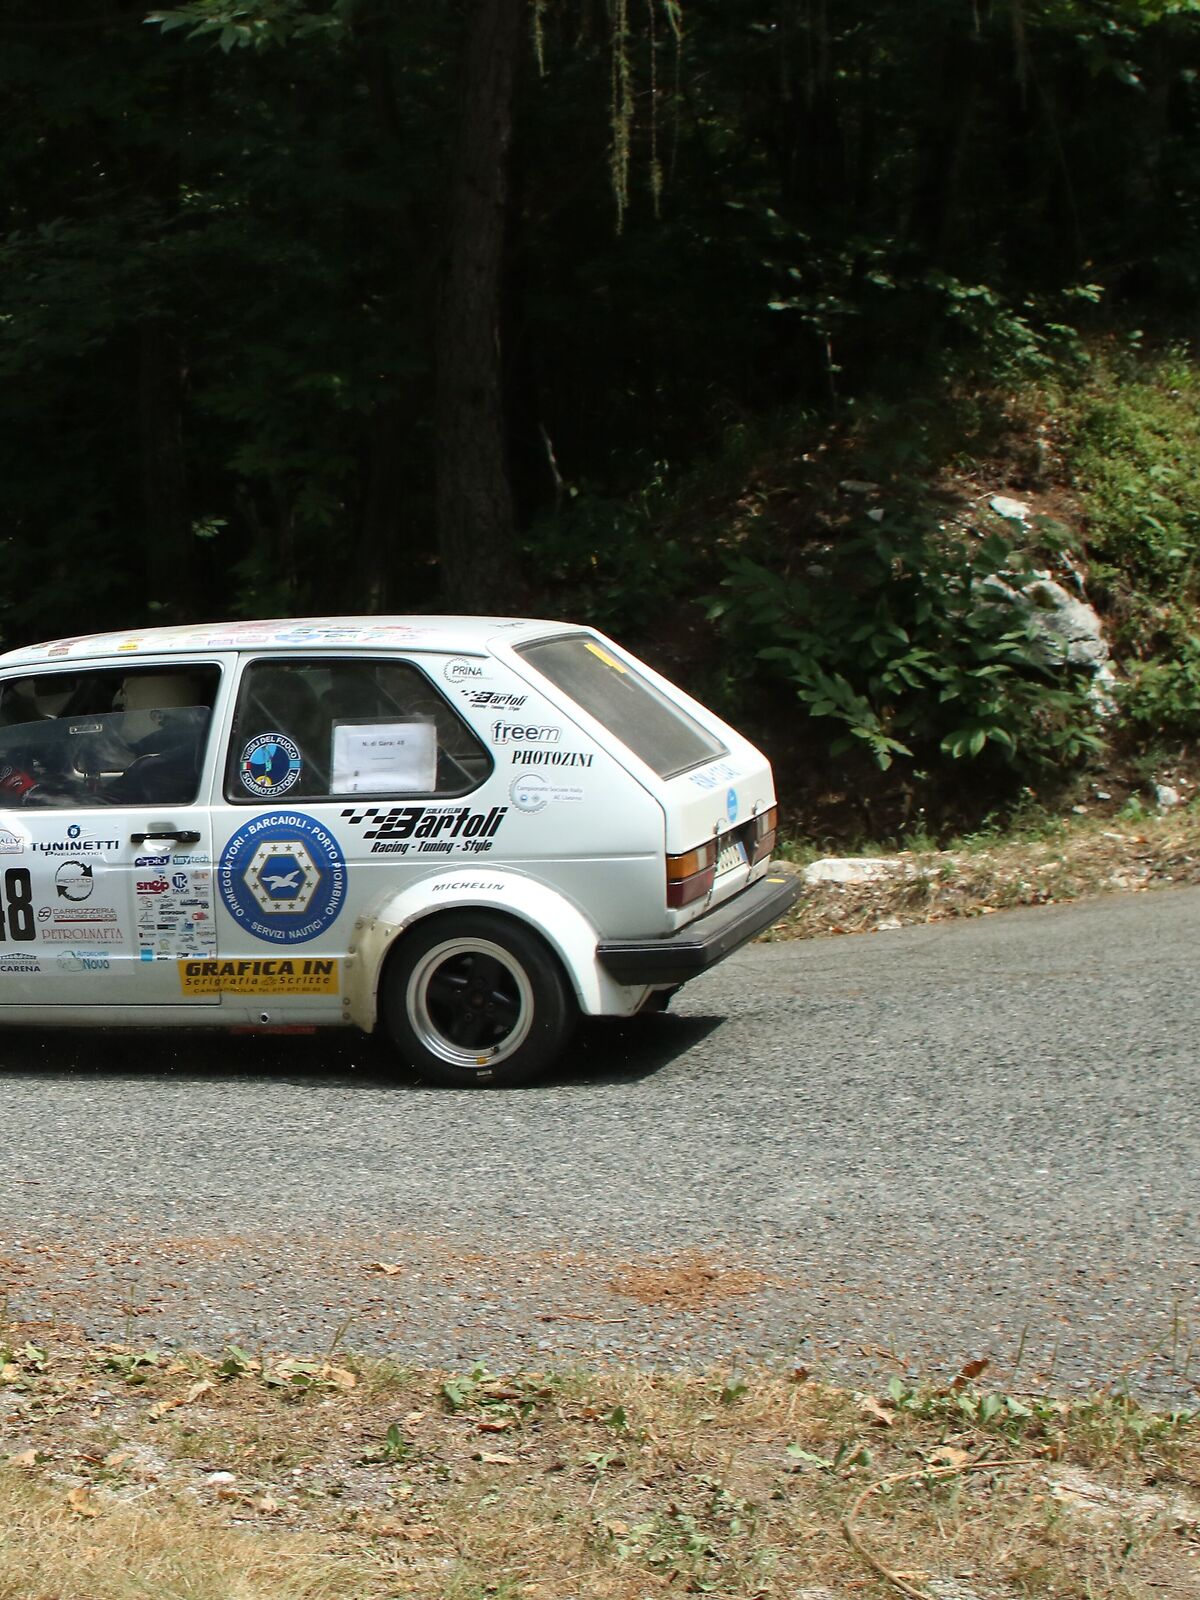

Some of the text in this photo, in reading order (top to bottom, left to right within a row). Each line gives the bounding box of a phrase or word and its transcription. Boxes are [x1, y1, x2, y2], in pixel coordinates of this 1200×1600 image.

[452, 665, 482, 677] PRINA
[469, 691, 528, 706] Bartoli
[494, 722, 559, 742] freem
[244, 736, 297, 760] VIGILI DEL FUOCO
[511, 750, 594, 767] PHOTOZINI
[242, 772, 297, 795] SOMMOZZATORI
[247, 816, 307, 835] BARCAIOLI
[363, 807, 508, 840] Bartoli
[31, 840, 119, 851] TUNINETTI
[311, 826, 338, 860] PORTO
[371, 841, 409, 856] Racing
[417, 840, 453, 855] Tuning
[462, 840, 492, 855] Style
[222, 838, 245, 917] ORMEGGIATORI
[325, 862, 343, 915] PIOMBINO
[432, 882, 505, 892] MICHELIN
[53, 907, 115, 915] CARROZZERIA
[251, 921, 285, 939] SERVIZI
[289, 919, 323, 939] NAUTICI
[185, 960, 334, 976] GRAFICA IN
[185, 977, 258, 986] Serigrafia
[279, 976, 330, 984] Scritte
